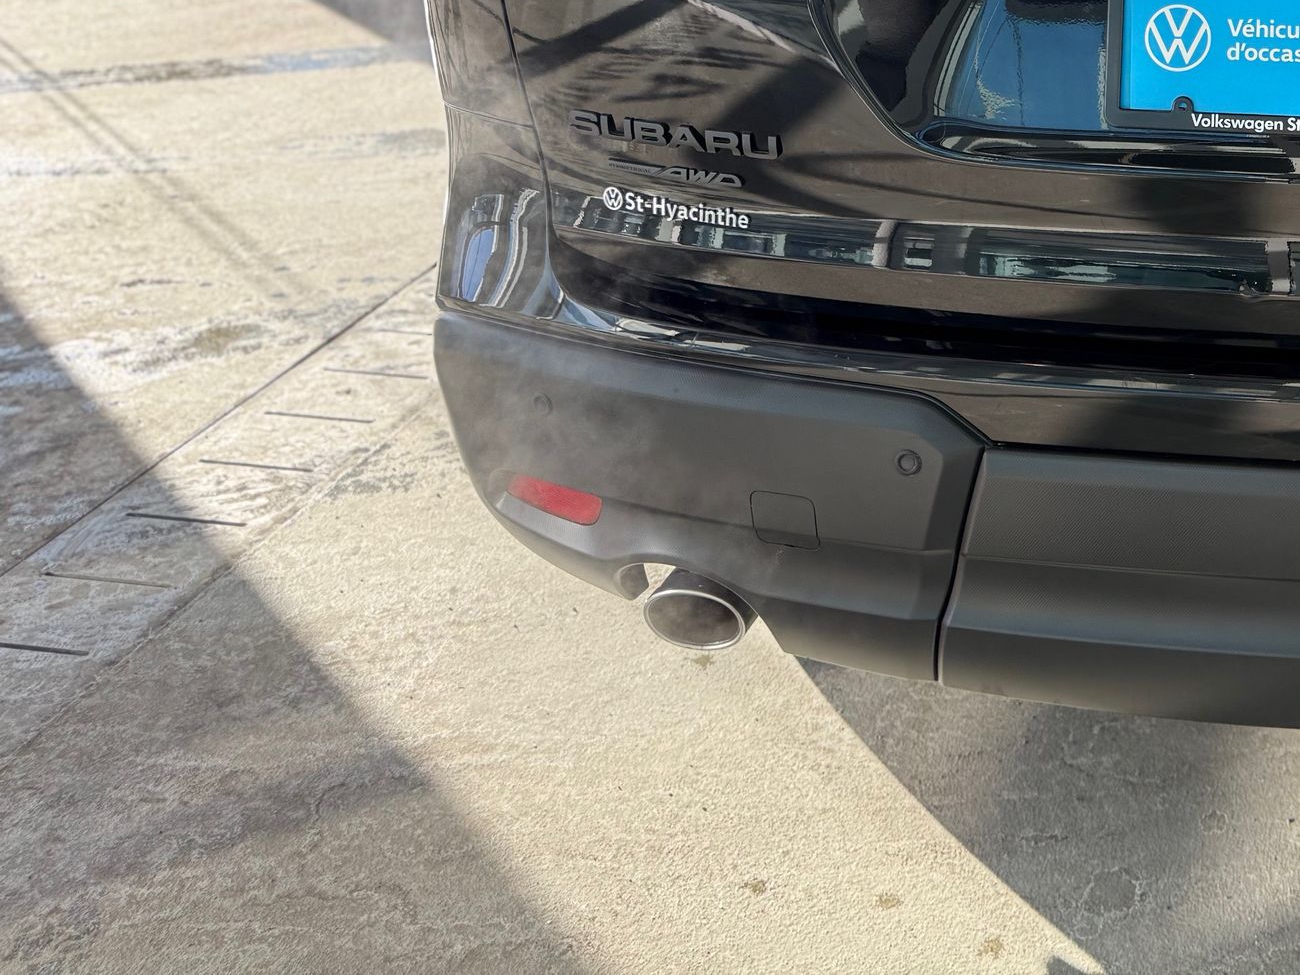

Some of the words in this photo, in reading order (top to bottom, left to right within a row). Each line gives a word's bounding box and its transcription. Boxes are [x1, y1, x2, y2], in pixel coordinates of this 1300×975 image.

[568, 108, 783, 161] SUBARU
[1191, 112, 1284, 135] Volkswagen
[657, 166, 746, 189] AWD
[624, 192, 749, 229] St-Hyacinthe
